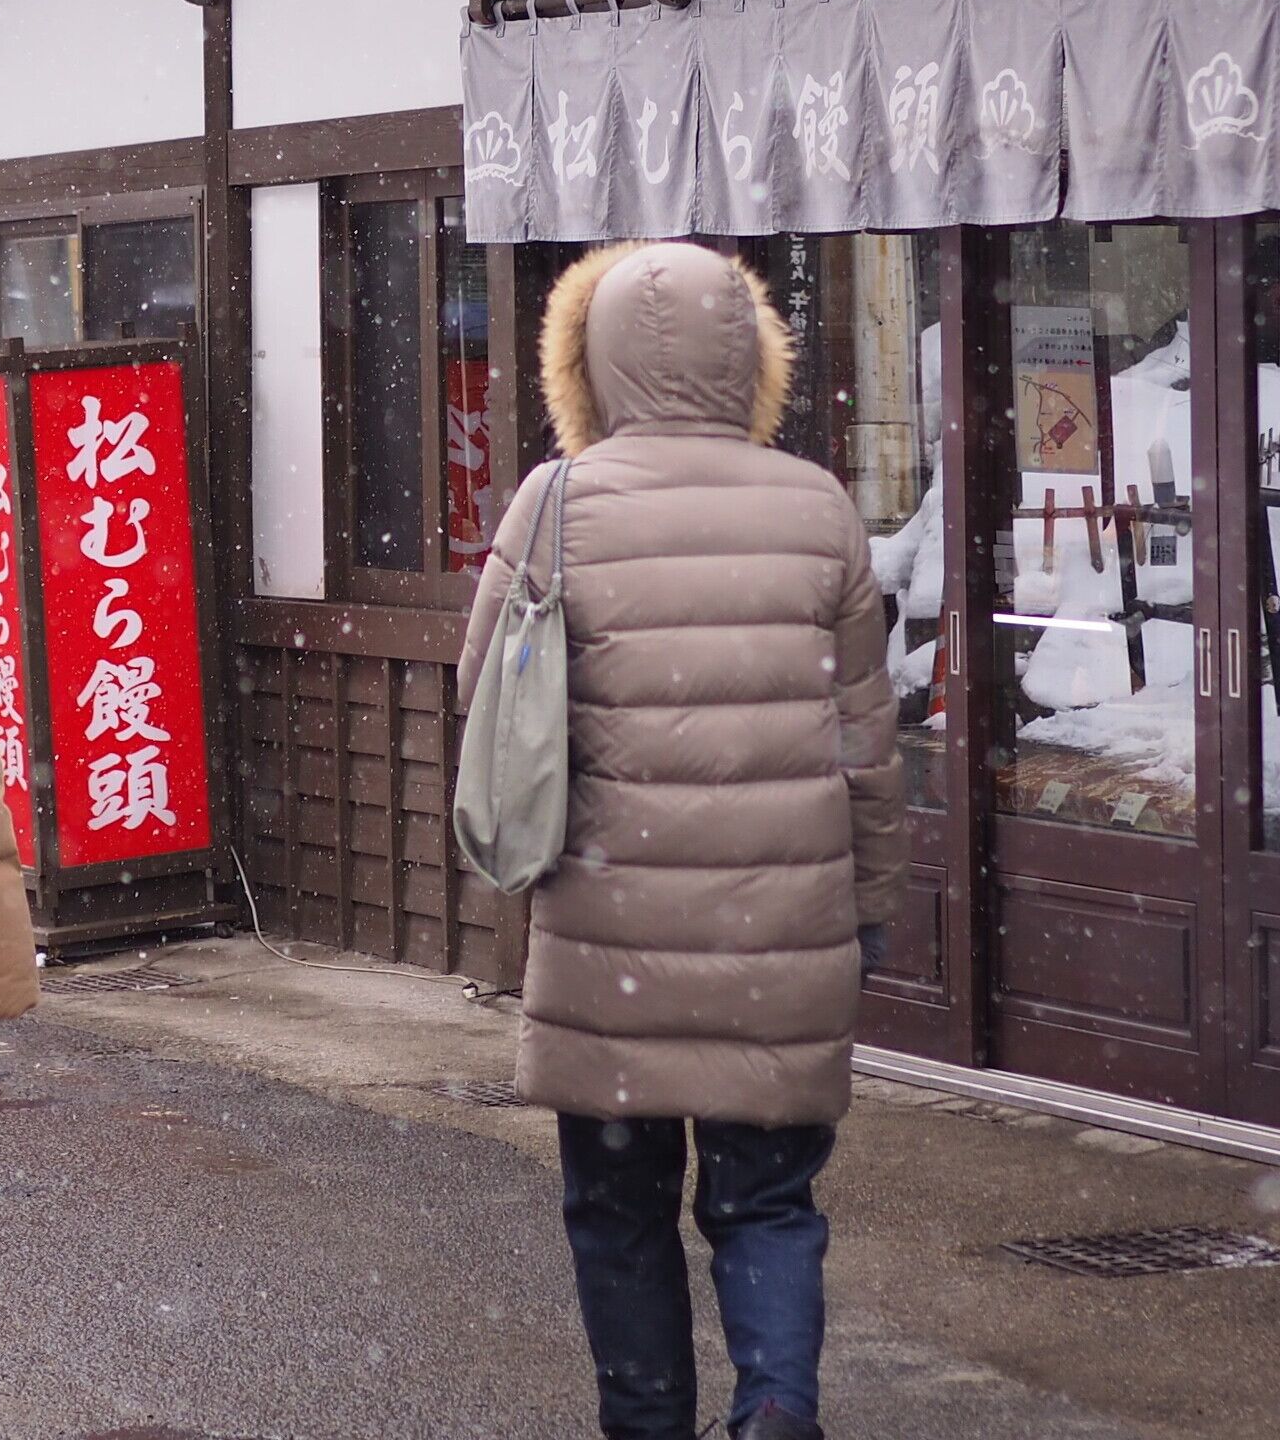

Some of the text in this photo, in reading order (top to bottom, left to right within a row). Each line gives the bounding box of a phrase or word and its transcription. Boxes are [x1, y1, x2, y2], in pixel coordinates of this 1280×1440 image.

[547, 61, 940, 185] 松むら饅頭
[67, 395, 177, 830] 松むら饅頭
